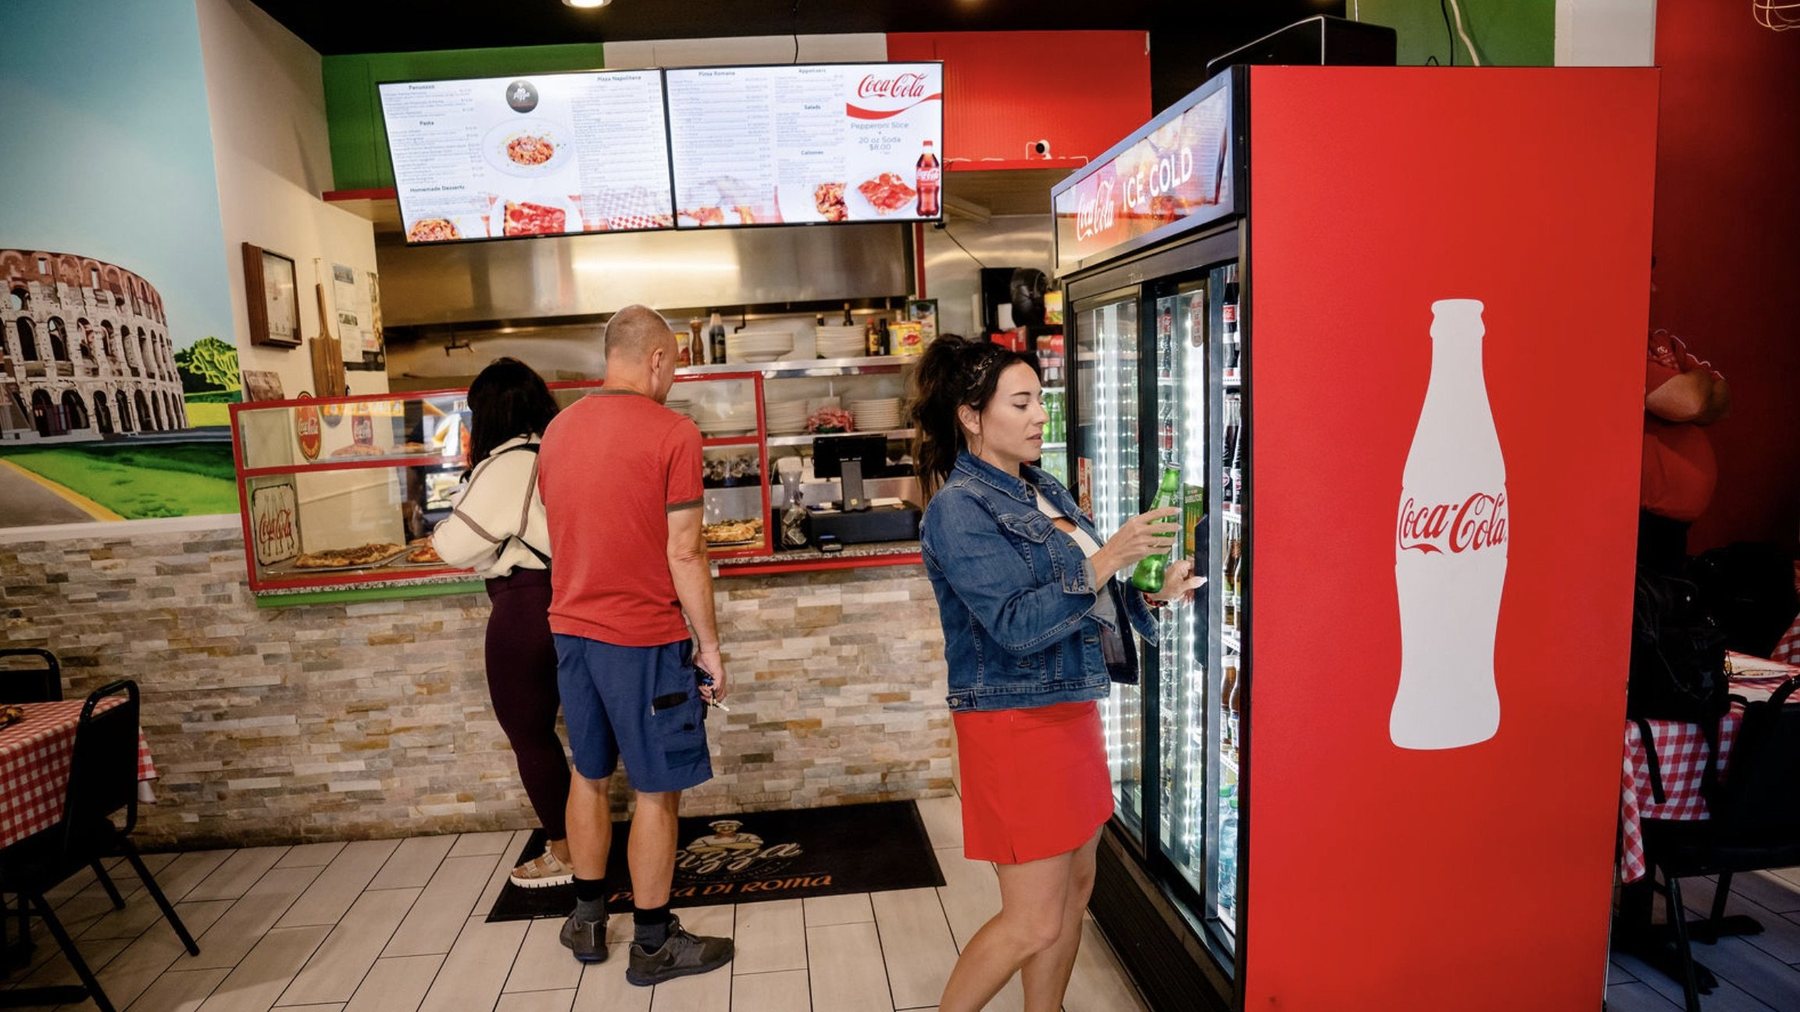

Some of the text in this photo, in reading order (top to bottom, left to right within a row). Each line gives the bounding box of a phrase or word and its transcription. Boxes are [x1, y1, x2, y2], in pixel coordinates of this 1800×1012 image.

[857, 73, 928, 98] Coca-Cola
[850, 122, 889, 130] Pepperoni
[881, 135, 901, 143] Soda
[1122, 171, 1146, 212] ICE
[1149, 147, 1193, 197] COLD
[1398, 492, 1507, 554] Coca-Cola
[702, 883, 733, 896] DI
